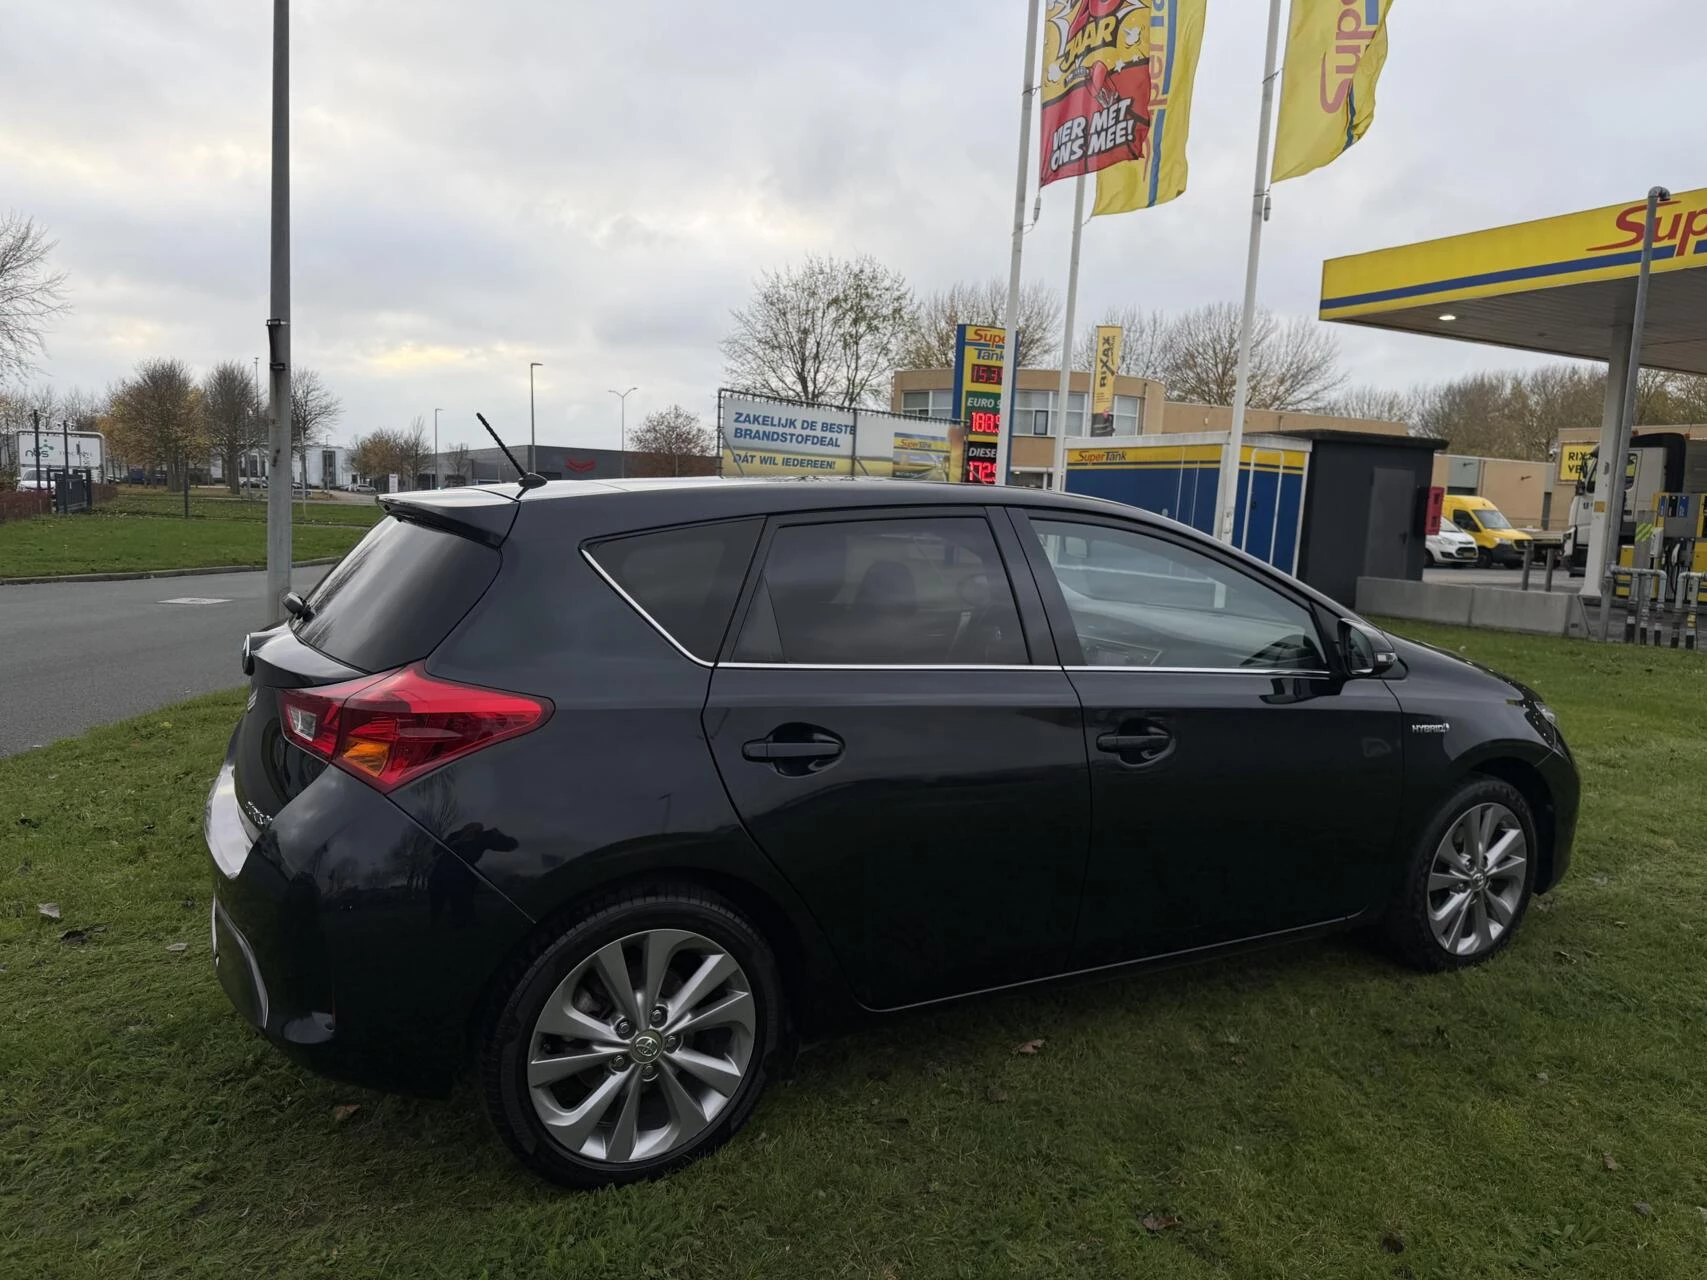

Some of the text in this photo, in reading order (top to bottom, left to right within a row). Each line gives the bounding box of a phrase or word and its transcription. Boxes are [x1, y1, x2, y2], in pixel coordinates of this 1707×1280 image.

[1061, 15, 1117, 72] JAAR
[1090, 98, 1132, 134] MET
[1050, 119, 1135, 171] ONS MEE!
[967, 397, 994, 408] EURO
[733, 412, 856, 435] ZAKELIJK DE BESTE
[733, 427, 841, 448] BRANDSTOFDEAL
[733, 452, 837, 470] DÁT WIL IEDEREEN!
[968, 447, 998, 458] DIESE
[1411, 724, 1446, 733] HYBRID
